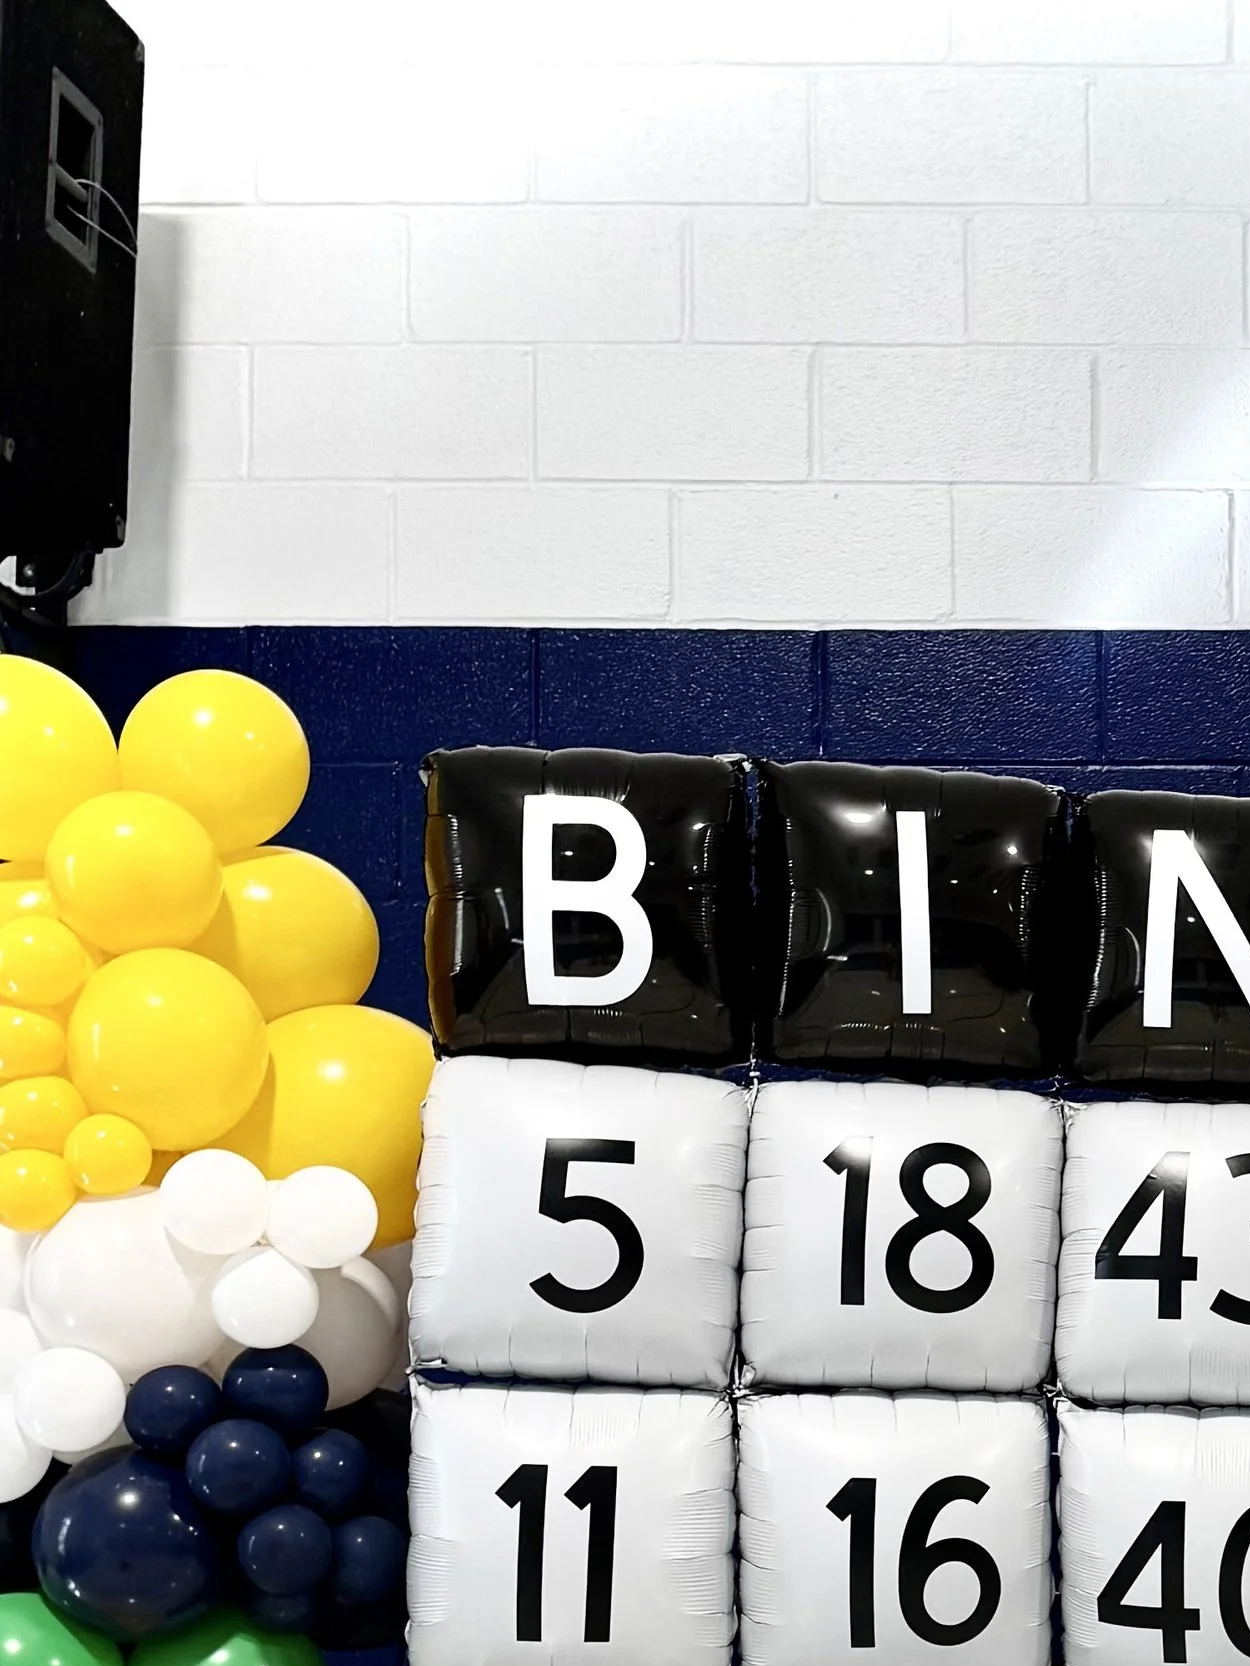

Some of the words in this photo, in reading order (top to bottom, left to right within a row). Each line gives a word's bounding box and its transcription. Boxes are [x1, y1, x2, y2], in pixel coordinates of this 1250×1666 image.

[529, 1139, 644, 1313] 5
[823, 1143, 994, 1313] 18
[495, 1464, 617, 1642] 11
[826, 1476, 1001, 1648] 16
